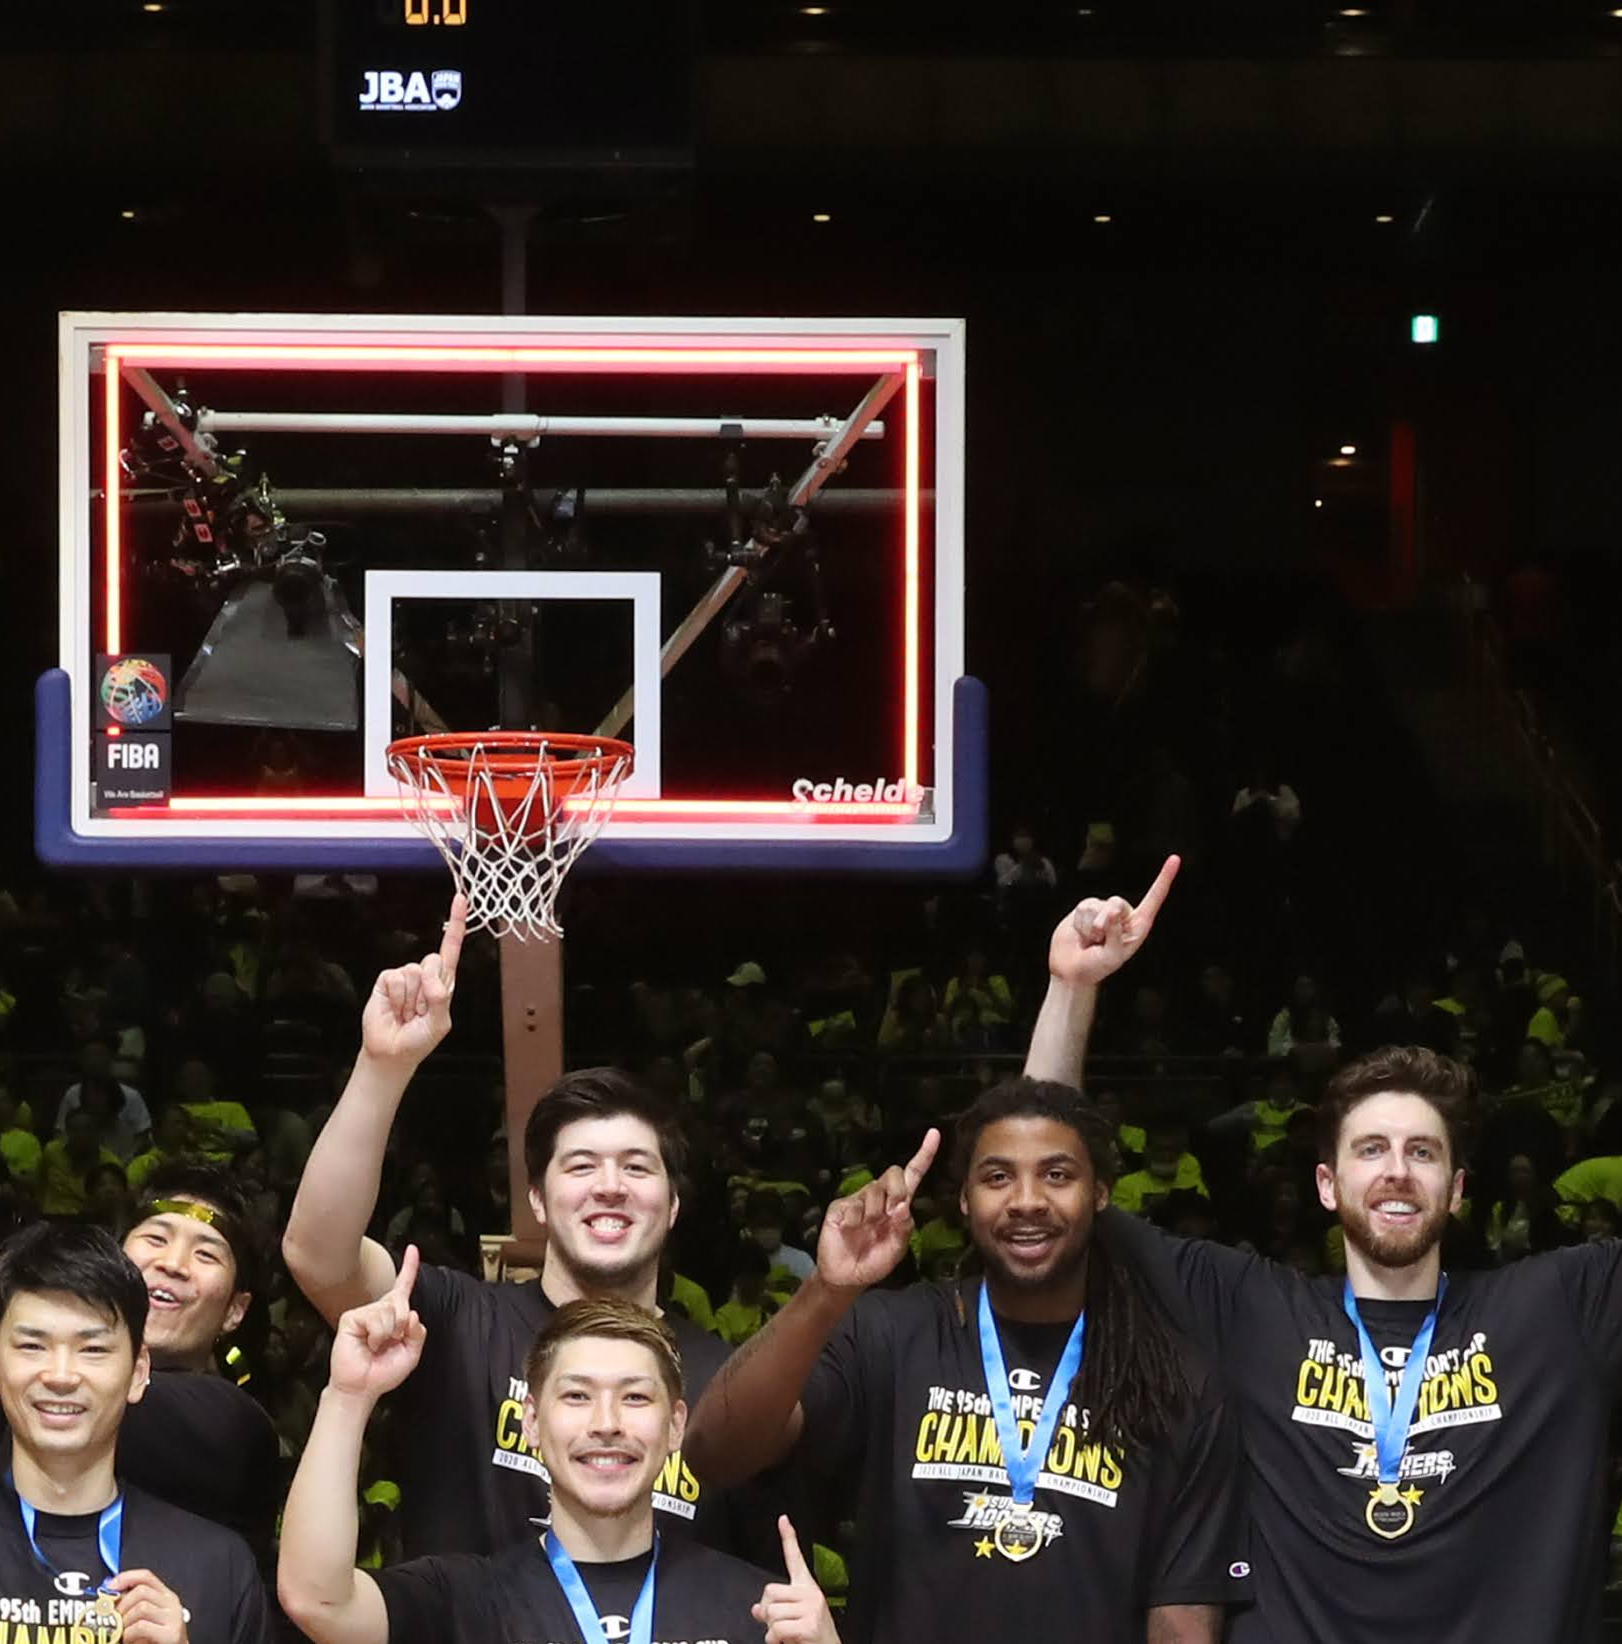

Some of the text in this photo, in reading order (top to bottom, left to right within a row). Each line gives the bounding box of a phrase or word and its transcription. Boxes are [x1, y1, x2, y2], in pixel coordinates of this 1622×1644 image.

[359, 71, 431, 104] JBA
[107, 743, 159, 769] FIBA
[1308, 1338, 1335, 1363] THE
[928, 1386, 991, 1417] THE 95th
[1430, 1406, 1494, 1427] CHAMPIONSHIP
[957, 1466, 982, 1480] JAPAN
[1047, 1475, 1111, 1501] CHAMPIONSHIP
[0, 1598, 41, 1624] 95th
